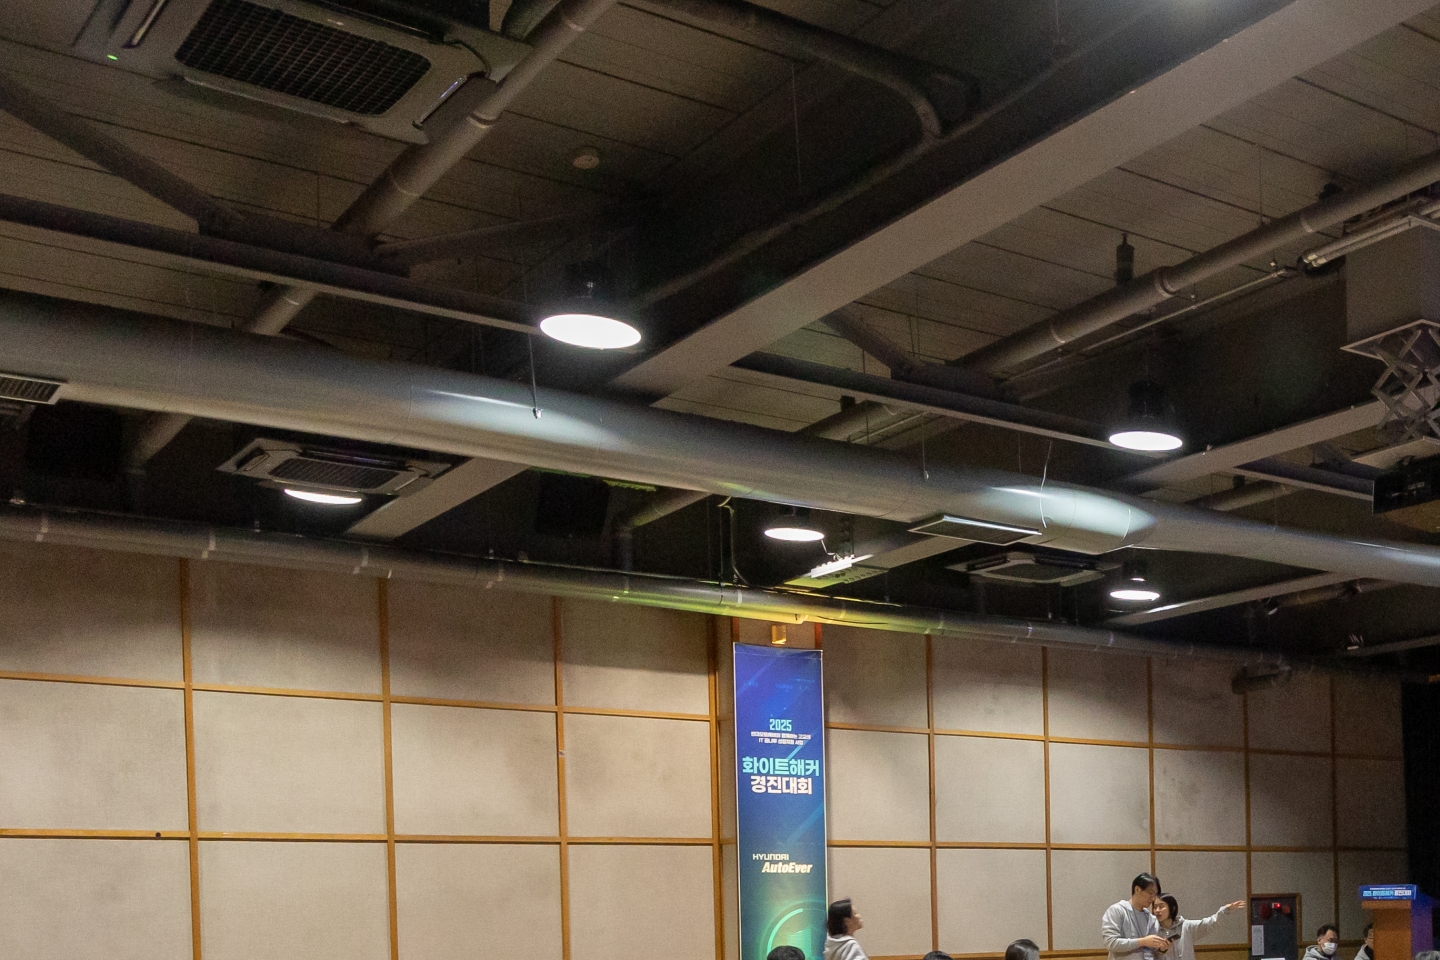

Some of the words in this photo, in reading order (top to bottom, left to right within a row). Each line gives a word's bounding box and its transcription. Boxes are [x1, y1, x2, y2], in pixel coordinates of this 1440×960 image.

[769, 719, 792, 731] 2025
[742, 756, 819, 776] 화이트해커
[751, 775, 812, 794] 경진대회
[762, 862, 813, 873] AutoEver
